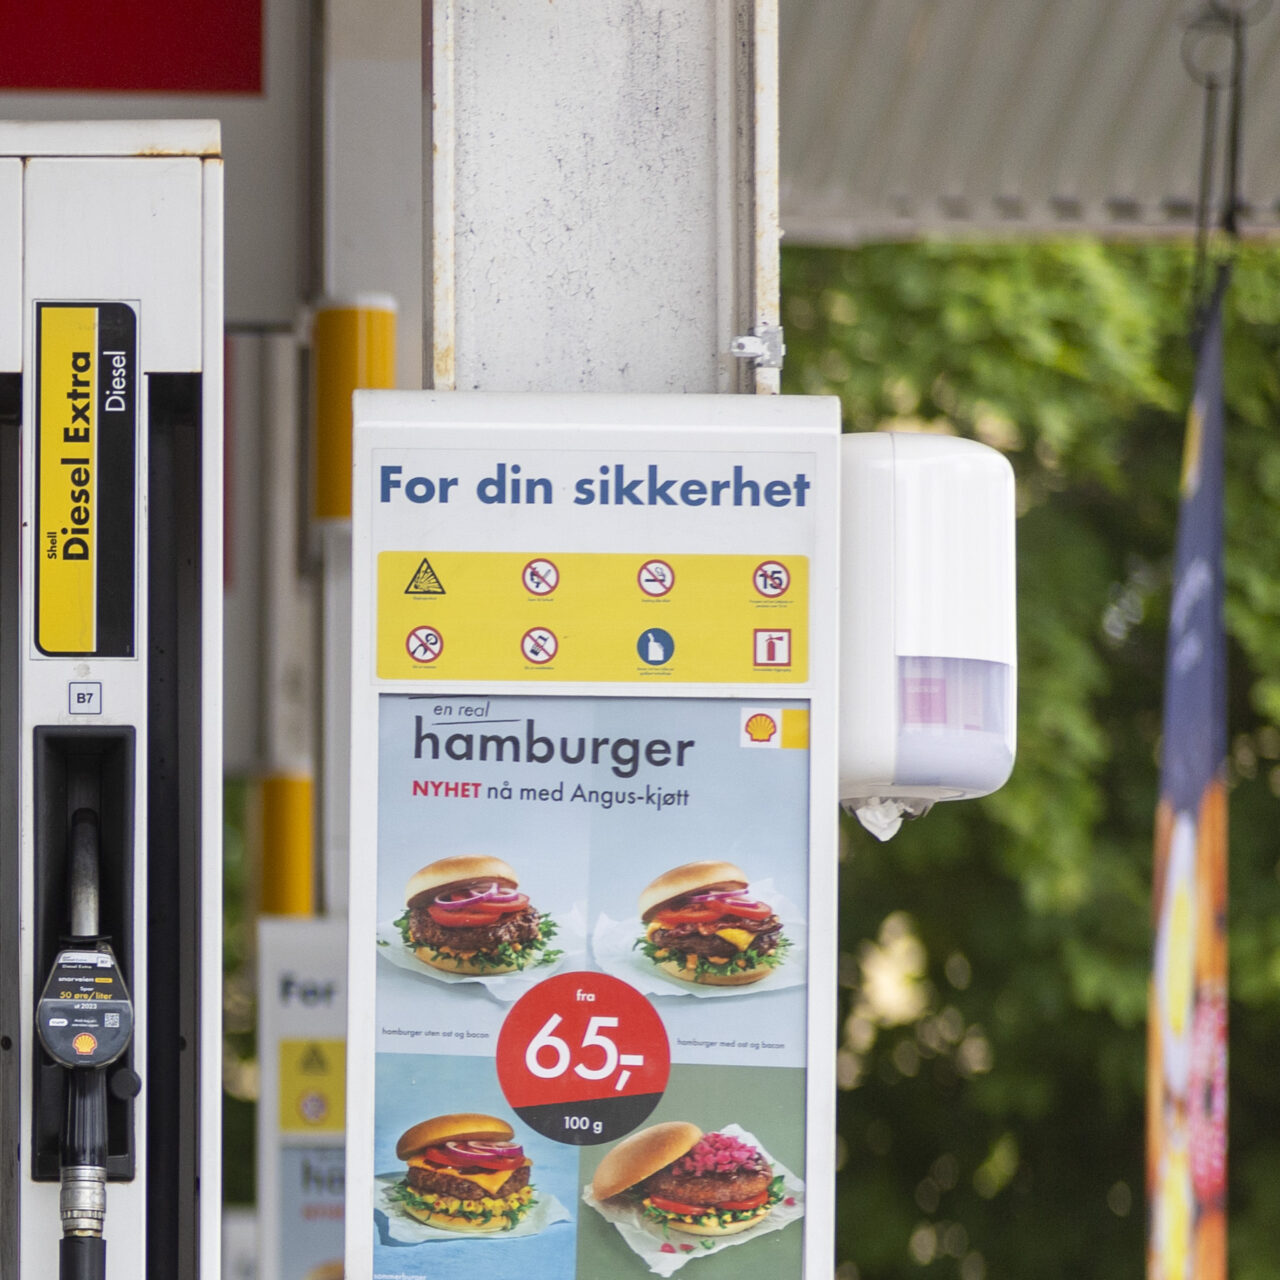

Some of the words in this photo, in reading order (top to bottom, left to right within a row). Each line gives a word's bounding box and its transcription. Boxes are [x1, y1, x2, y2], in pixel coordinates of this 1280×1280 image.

[102, 351, 126, 411] Diesel
[63, 352, 91, 443] Extra
[379, 465, 458, 504] For
[476, 463, 553, 504] din
[573, 464, 811, 507] sikkerhet
[60, 458, 90, 561] Diesel
[47, 532, 57, 559] Shell
[759, 570, 783, 590] 15
[76, 693, 94, 704] B7
[434, 704, 452, 716] en
[458, 701, 490, 717] real
[414, 715, 695, 779] hamburger
[412, 780, 482, 798] NYHET
[487, 781, 512, 800] nå
[520, 781, 564, 801] med
[570, 784, 690, 811] Angus-kjøtt
[576, 989, 595, 1002] fra
[382, 1027, 422, 1038] hamburger
[466, 1030, 490, 1038] bacon
[677, 1038, 717, 1048] hamburger
[525, 1013, 644, 1092] 65,-
[564, 1116, 589, 1130] 100
[592, 1121, 603, 1134] g
